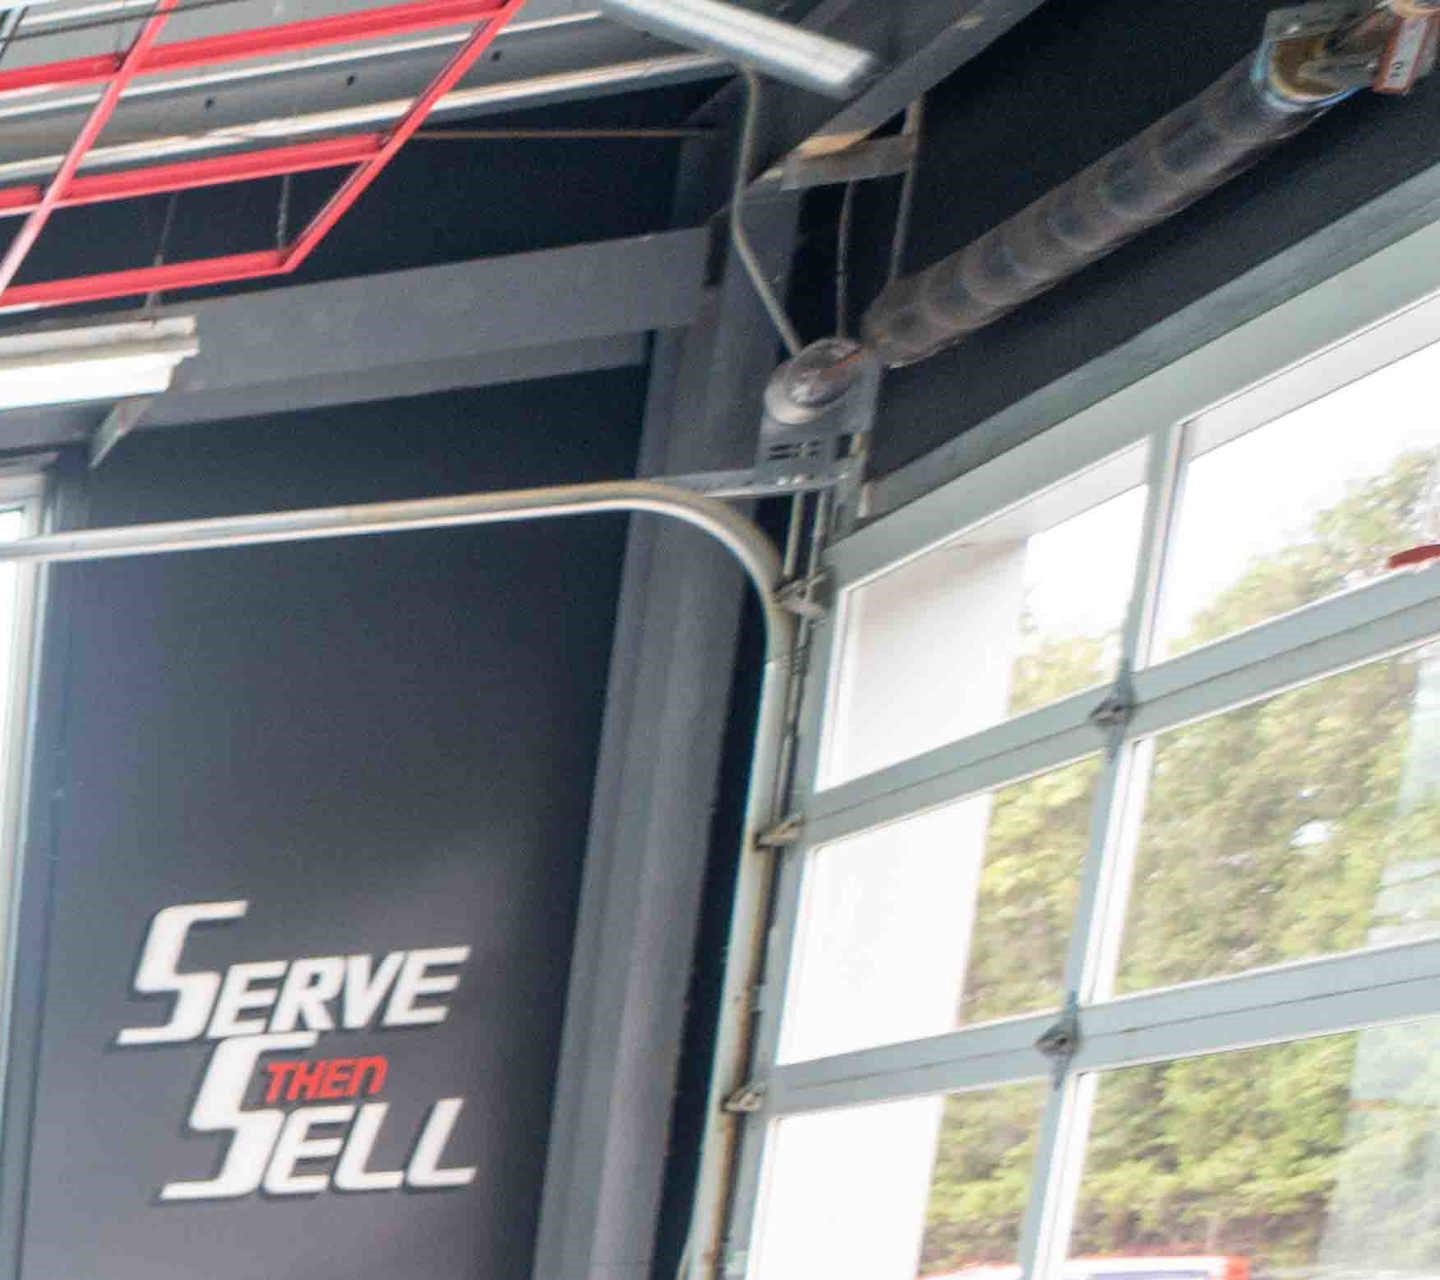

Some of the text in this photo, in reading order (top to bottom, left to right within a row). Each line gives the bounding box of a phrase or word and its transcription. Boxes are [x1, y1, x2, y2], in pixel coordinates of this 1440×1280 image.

[116, 900, 471, 1046] SERVE
[158, 1030, 476, 1201] SELL
[261, 1054, 388, 1102] THEN
